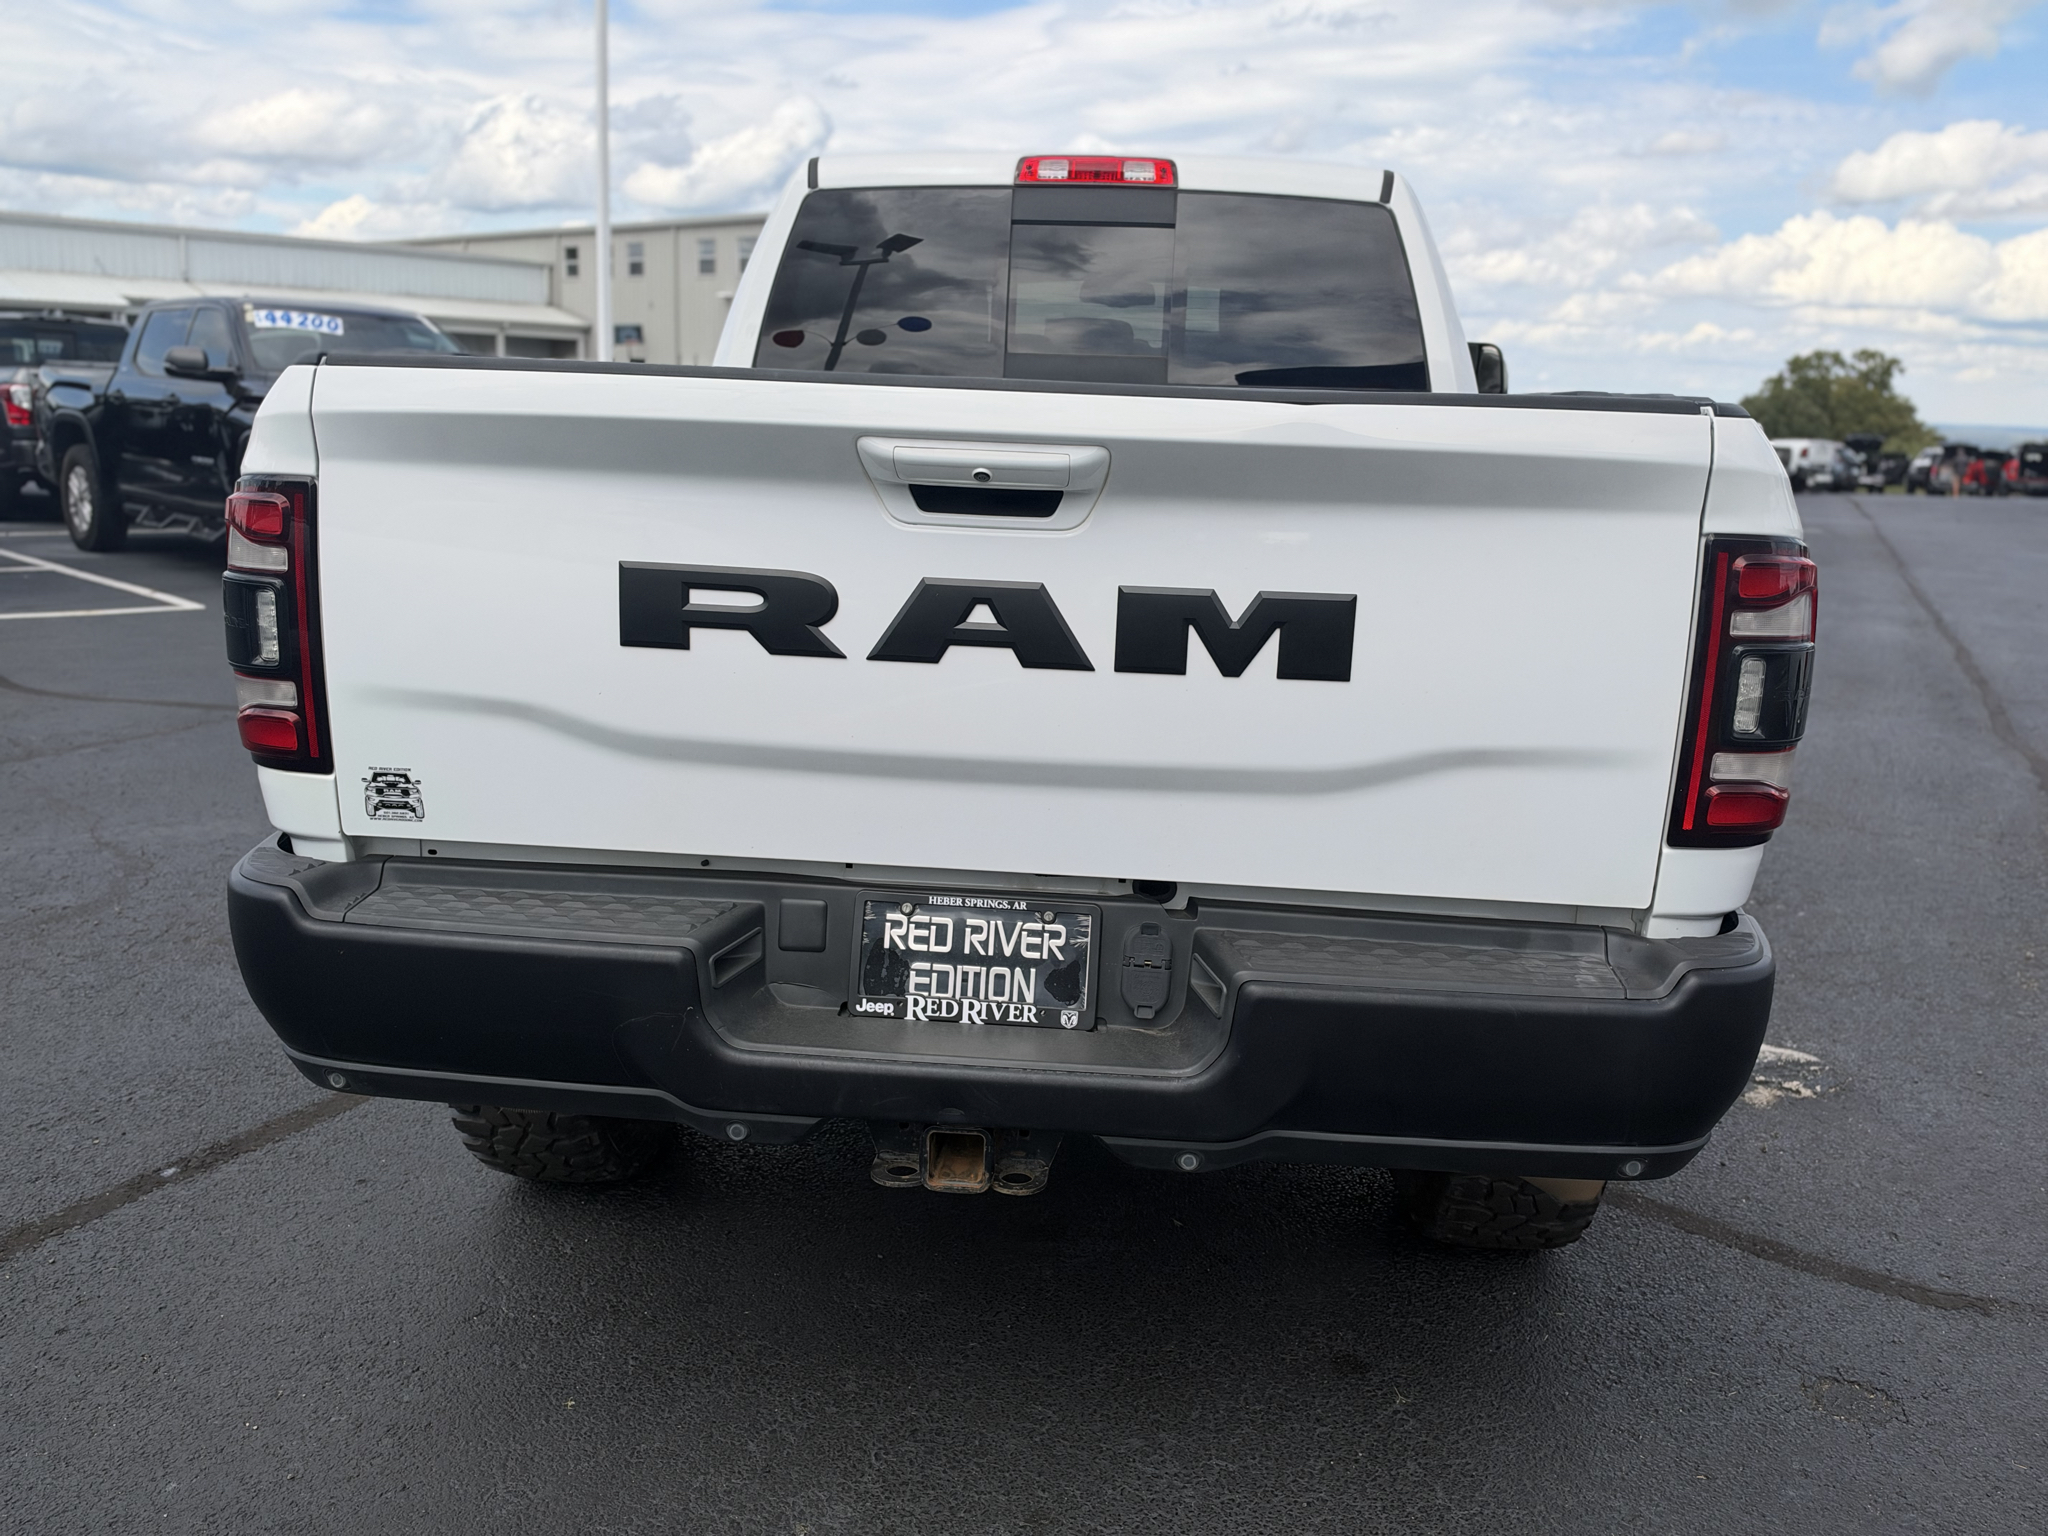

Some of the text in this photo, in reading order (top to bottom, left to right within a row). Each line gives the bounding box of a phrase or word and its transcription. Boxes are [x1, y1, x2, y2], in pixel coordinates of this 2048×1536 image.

[618, 560, 1357, 682] RAM
[928, 896, 1028, 911] HEBER SPRINGS, AR
[884, 913, 1067, 961] RED RIVER
[909, 962, 1036, 1003] EDITION
[856, 998, 895, 1016] Jeep
